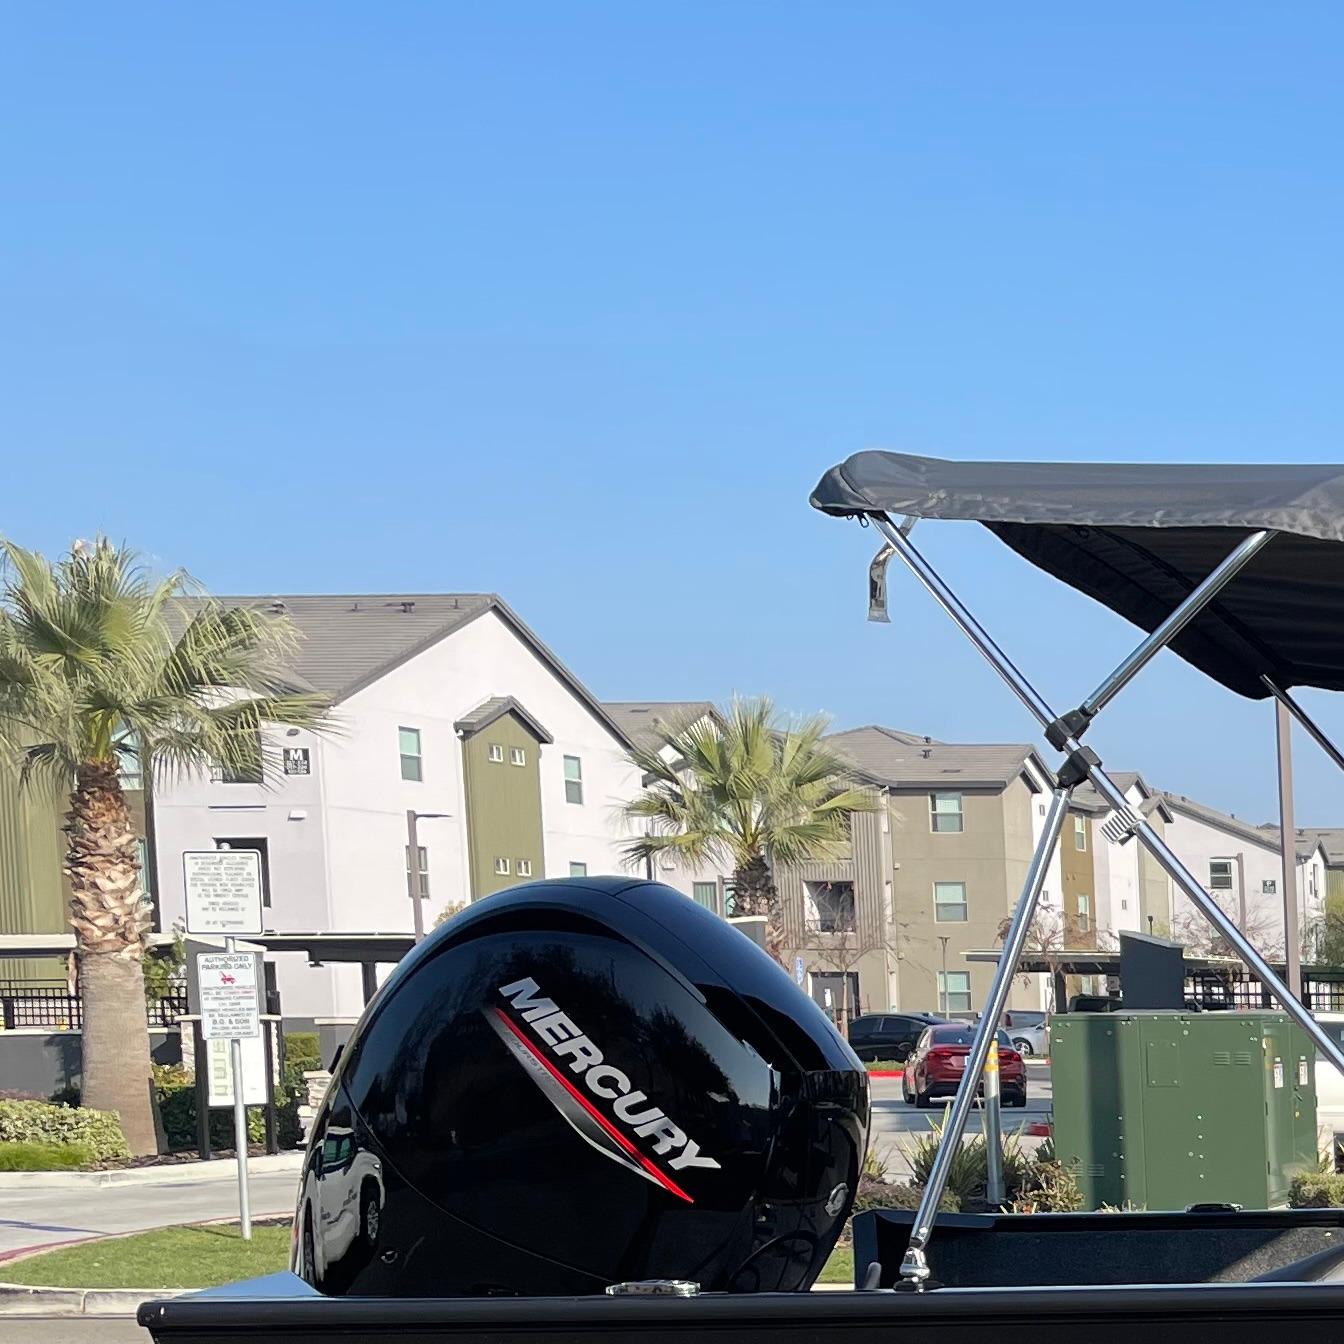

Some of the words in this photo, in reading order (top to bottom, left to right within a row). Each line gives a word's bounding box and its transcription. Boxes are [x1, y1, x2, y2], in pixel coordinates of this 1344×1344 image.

[290, 749, 303, 761] M
[204, 955, 249, 963] AUTHORIZED
[202, 963, 232, 971] PARKING
[234, 962, 252, 970] ONLY
[499, 977, 721, 1170] MERCURY
